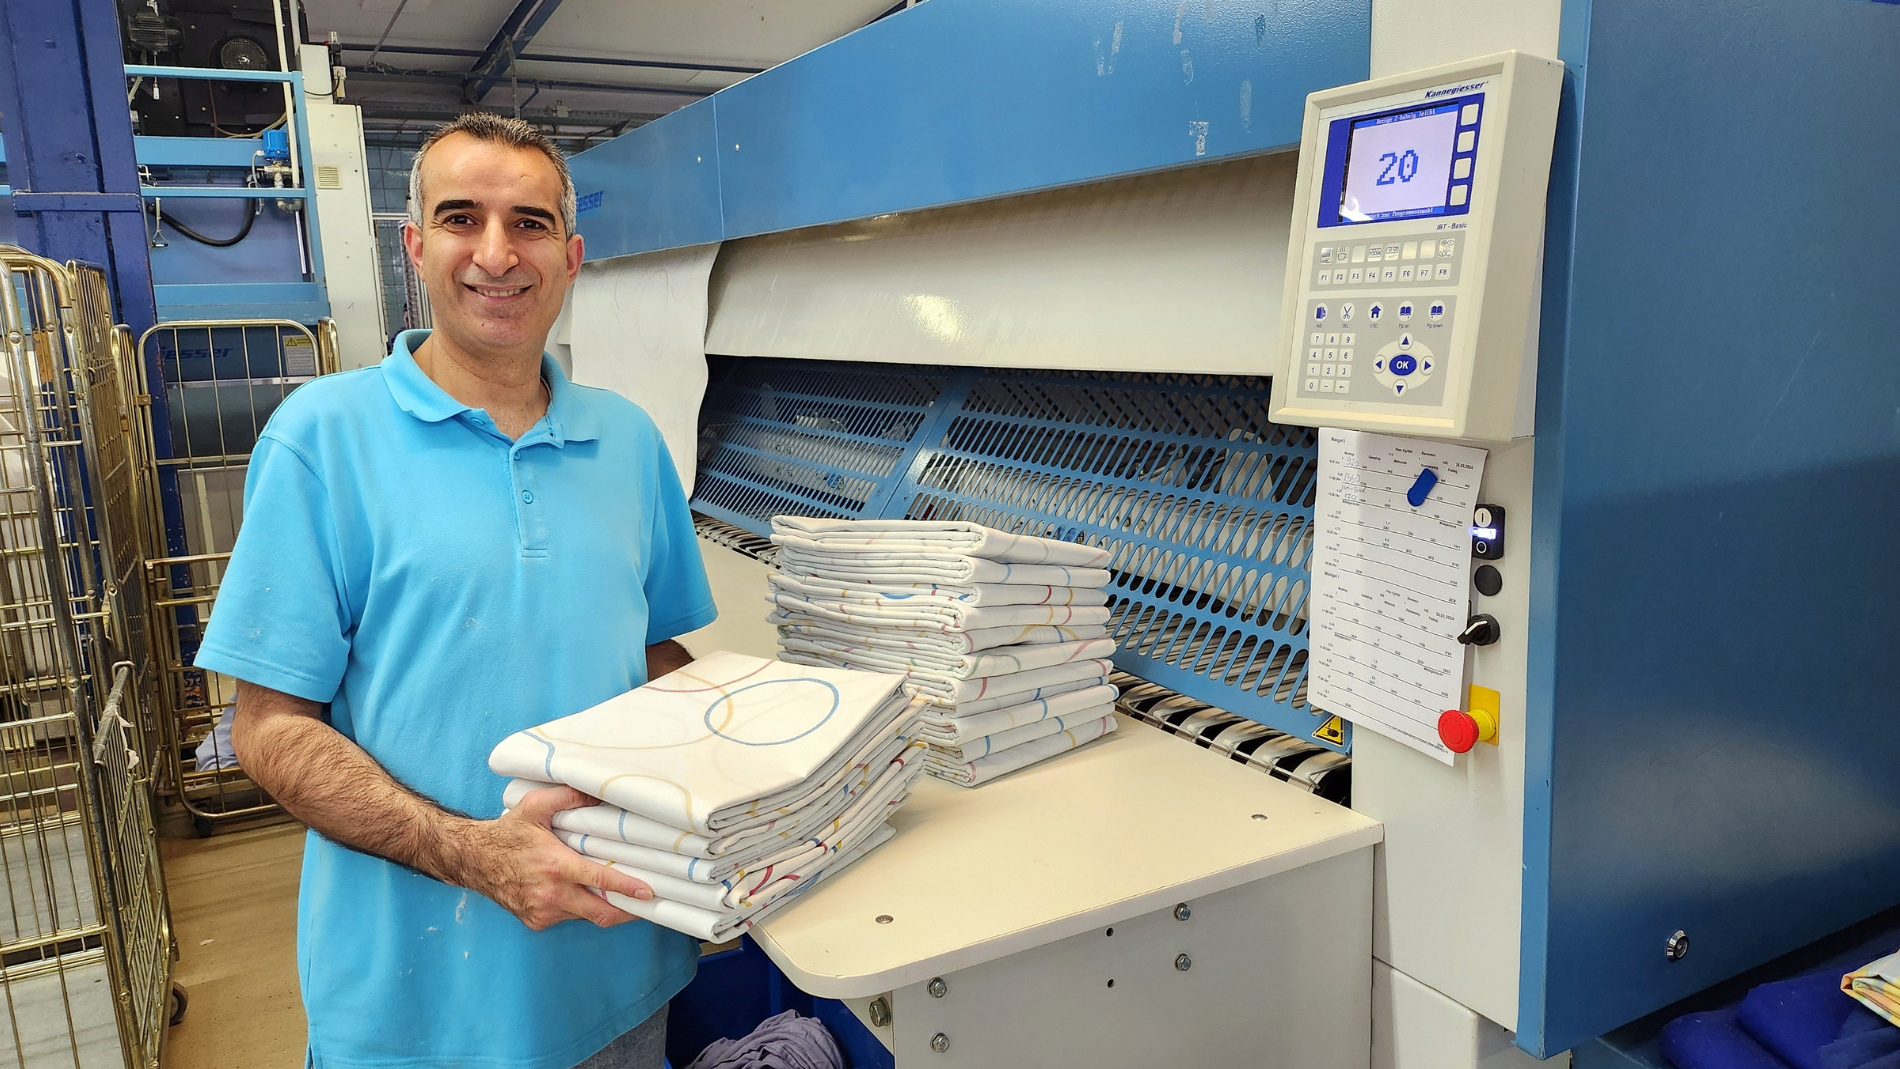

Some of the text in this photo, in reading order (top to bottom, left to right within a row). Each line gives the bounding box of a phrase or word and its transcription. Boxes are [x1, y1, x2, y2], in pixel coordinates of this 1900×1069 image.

[1424, 81, 1485, 99] Kannegiesser
[1376, 149, 1419, 187] 20
[1451, 222, 1468, 230] Basic
[1321, 273, 1328, 281] F1
[1421, 269, 1429, 277] F7
[1439, 268, 1447, 276] F8
[1396, 360, 1409, 370] OK
